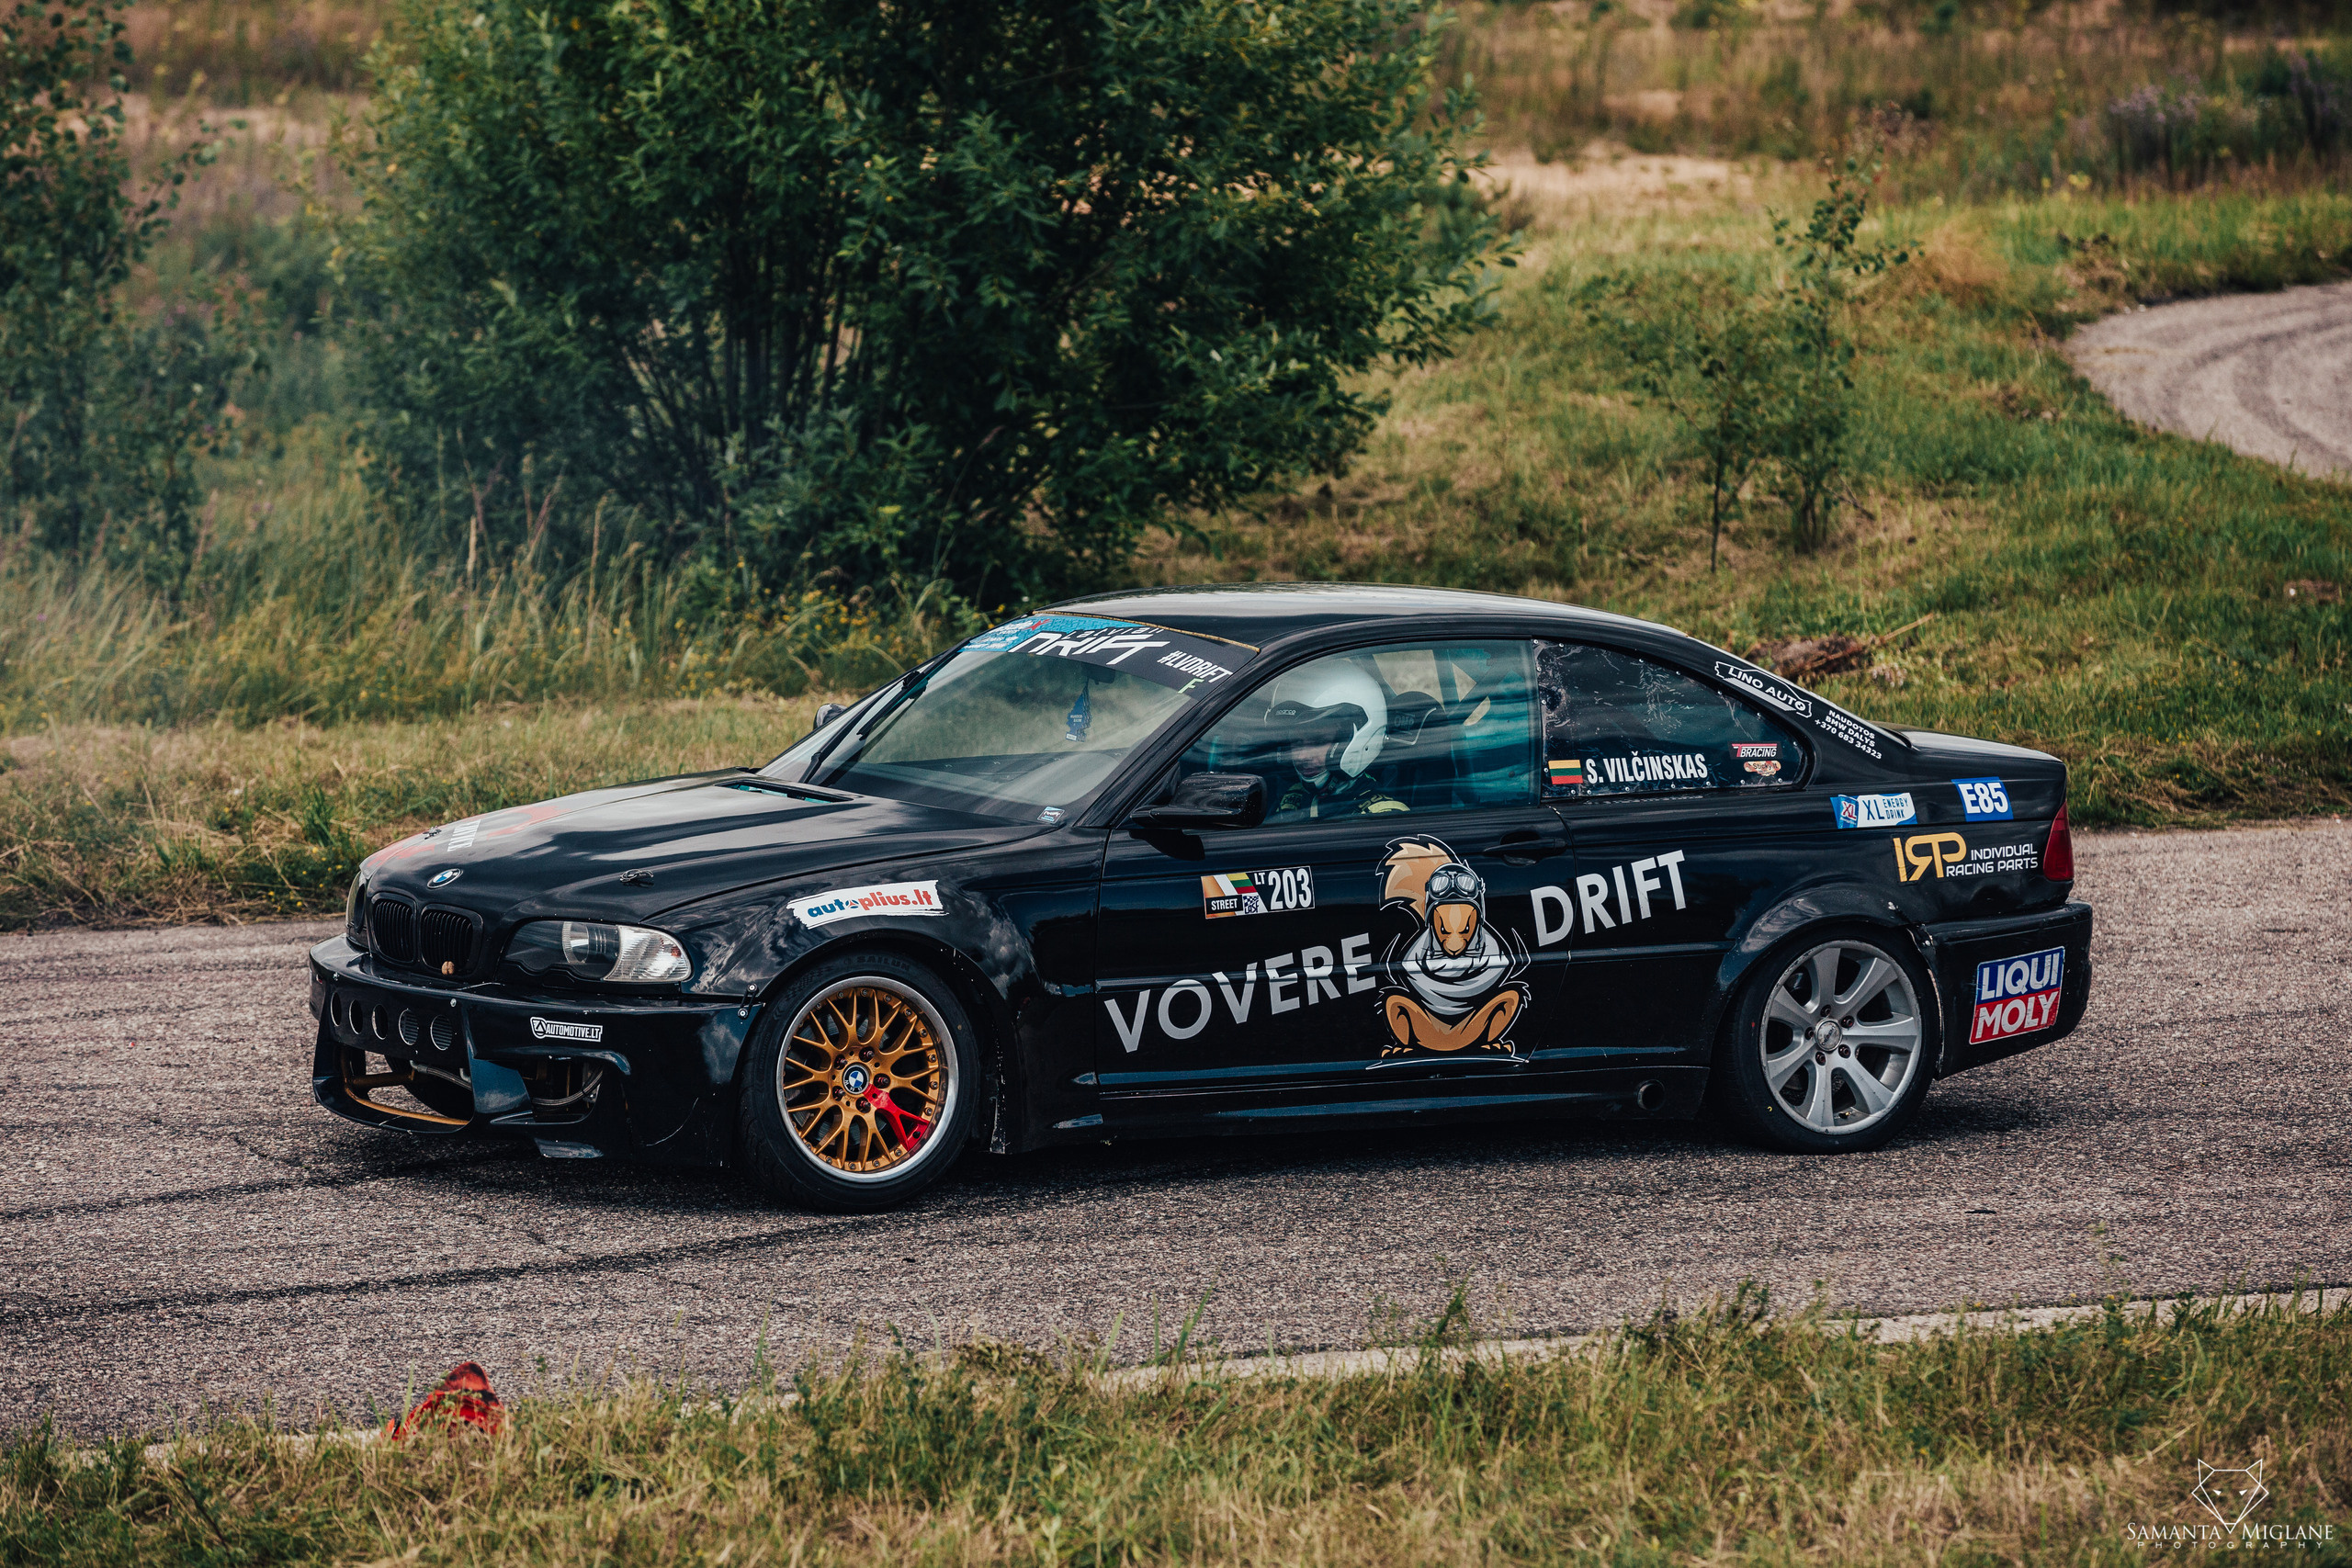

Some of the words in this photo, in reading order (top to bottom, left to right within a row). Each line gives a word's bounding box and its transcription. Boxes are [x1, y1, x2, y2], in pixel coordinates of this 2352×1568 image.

[1157, 650, 1234, 683] #LVDRIFT
[1728, 666, 1763, 689] LINO
[1765, 686, 1806, 712] AUTO
[1825, 716, 1847, 731] BMW
[1848, 728, 1876, 747] DALYS
[1828, 709, 1875, 739] NAUDOTOS
[1815, 719, 1838, 735] +370
[1838, 731, 1854, 744] 683
[1855, 740, 1883, 761] 34323
[1586, 758, 1604, 784] S.
[1602, 750, 1708, 783] VILČINSKAS
[1862, 799, 1885, 820] XL
[1883, 797, 1908, 808] ENERGY
[1958, 782, 2009, 814] E85
[1885, 809, 1905, 819] DRINK
[1946, 862, 1994, 877] RACING
[1997, 857, 2039, 872] PARTS
[1971, 843, 2038, 861] INDIVIDUAL
[808, 889, 933, 918] autoplius.lt
[1211, 898, 1238, 911] STREET
[1254, 873, 1266, 886] LT
[1268, 868, 1312, 910] 203
[1104, 932, 1376, 1053] VOVERE
[1530, 850, 1689, 947] DRIFT
[1981, 953, 2061, 1000] LIQUI
[1975, 991, 2059, 1039] MOLY
[545, 1023, 600, 1039] AUTOMOTIVE.LT
